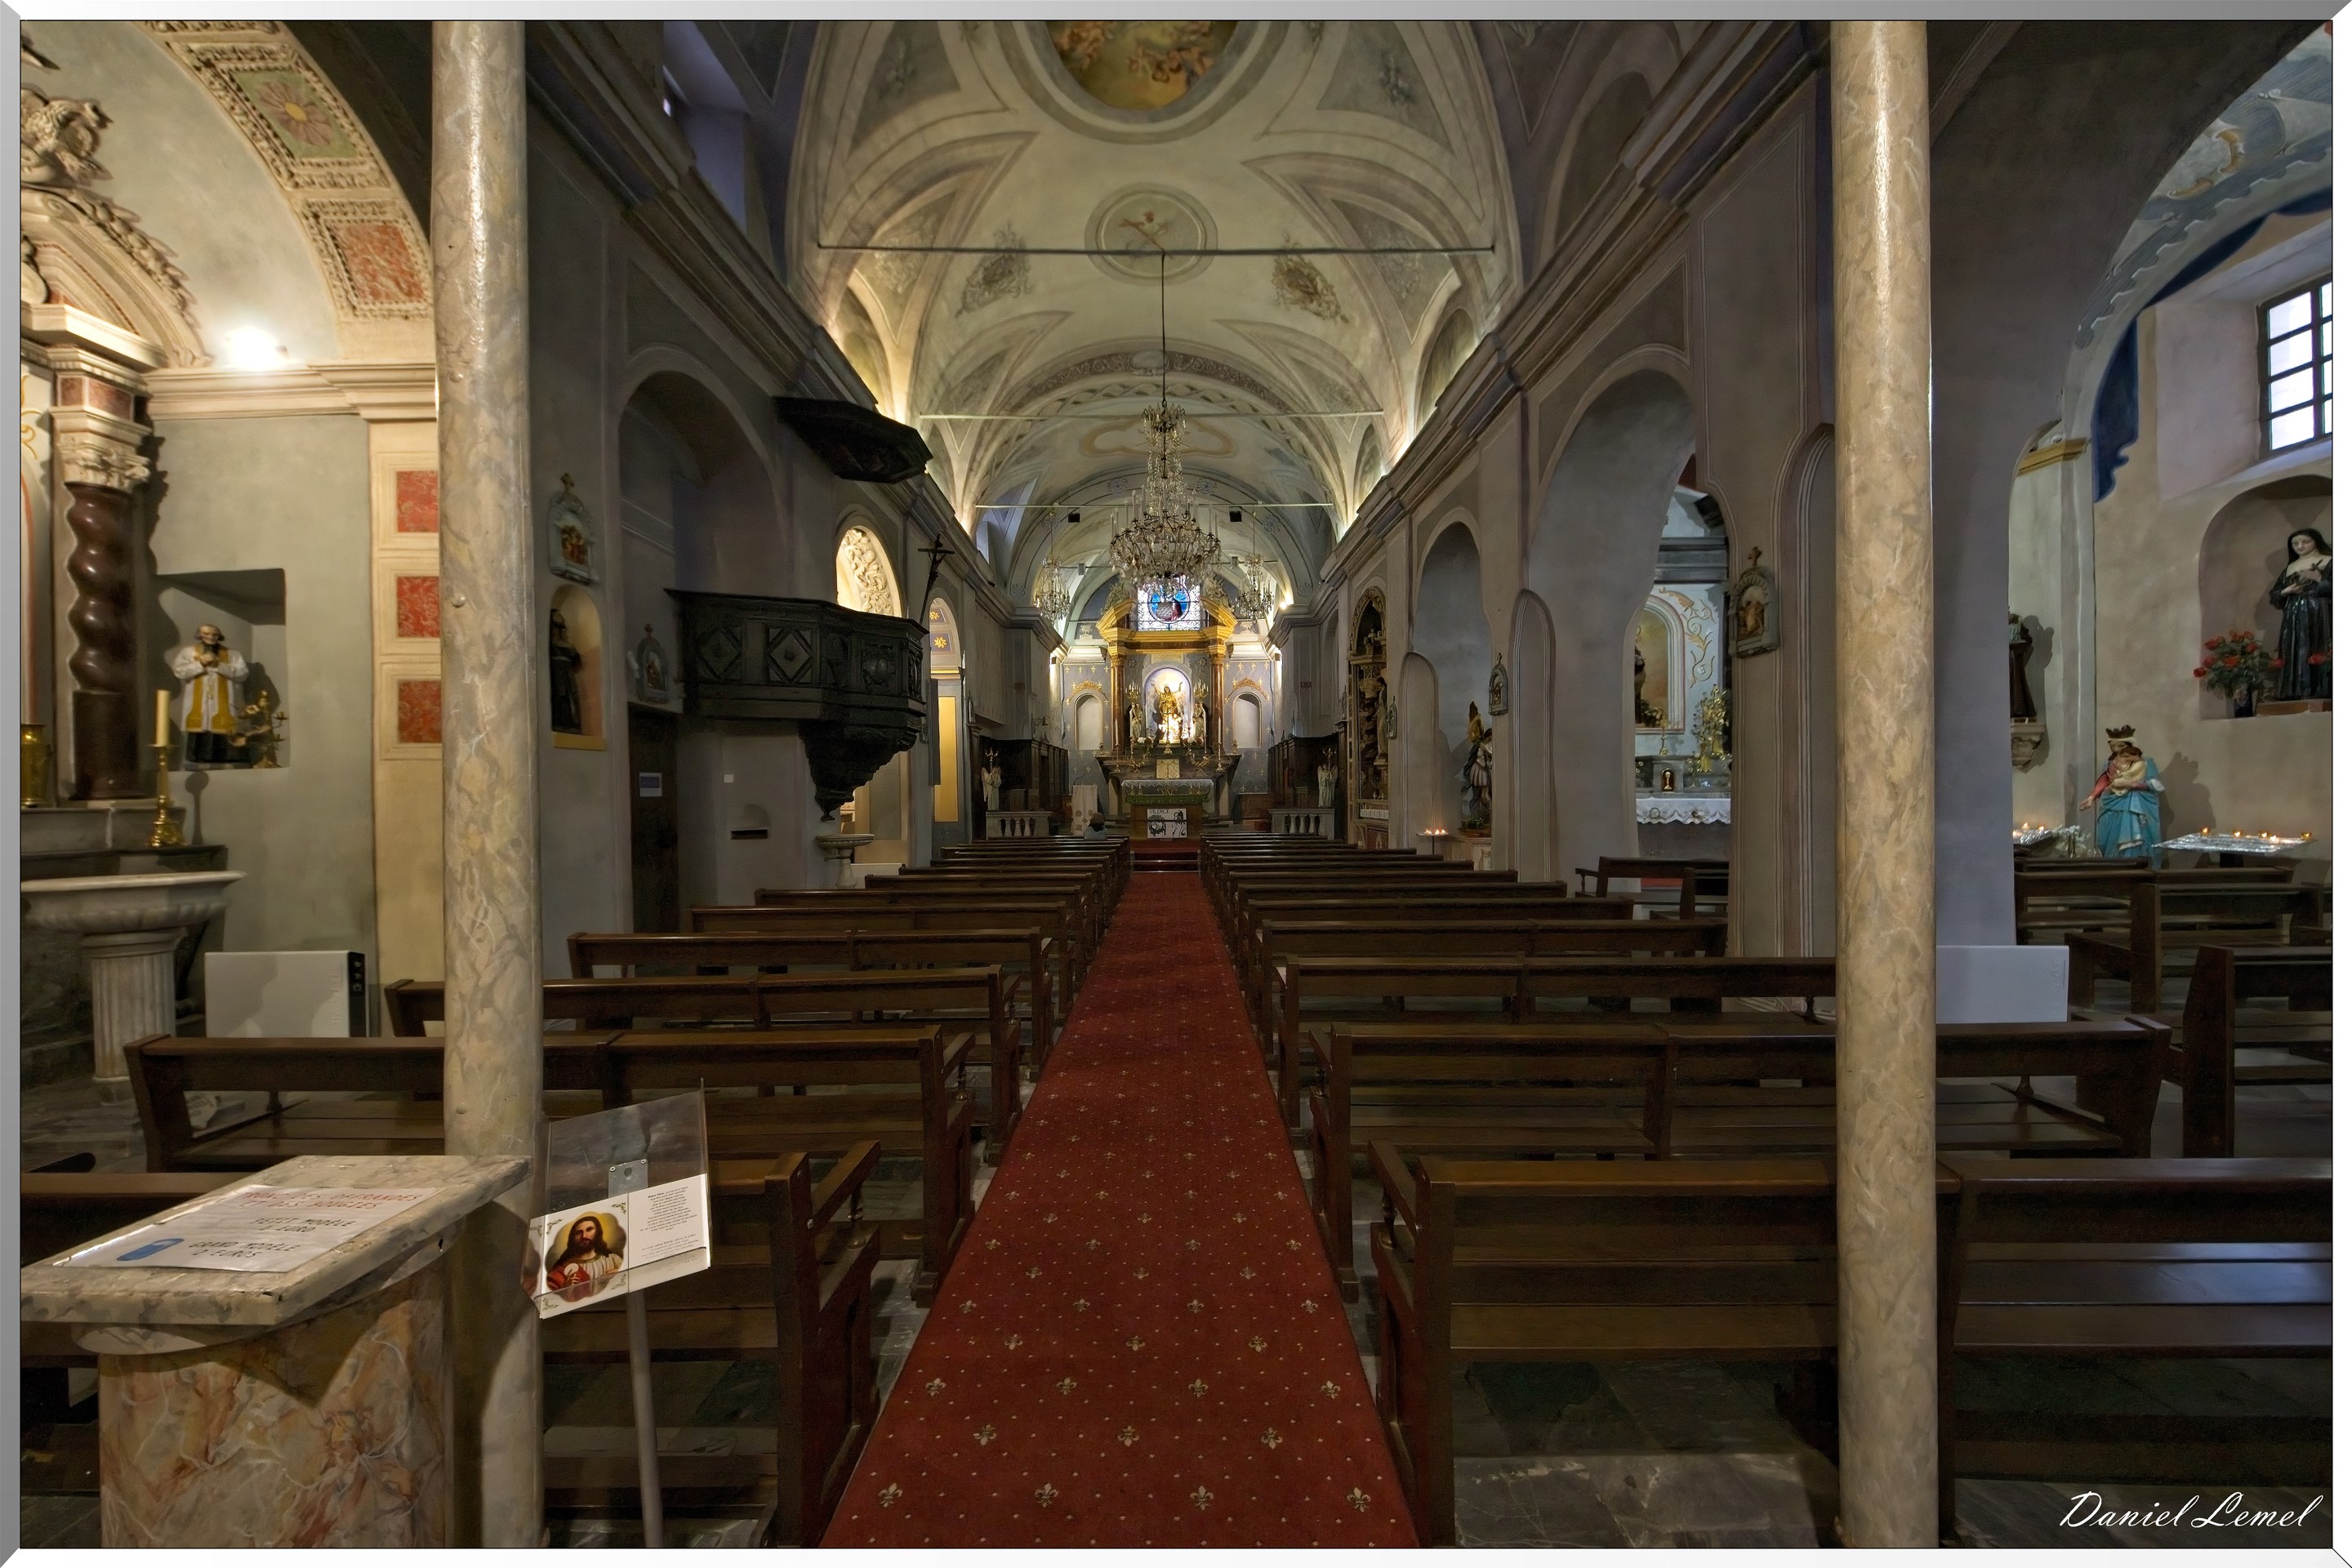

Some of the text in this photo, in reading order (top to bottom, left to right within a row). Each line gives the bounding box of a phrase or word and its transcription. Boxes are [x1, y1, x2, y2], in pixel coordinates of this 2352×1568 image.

[299, 1218, 357, 1227] MODÈLE
[239, 1242, 301, 1252] MODÈLE
[210, 1250, 263, 1258] EUROS
